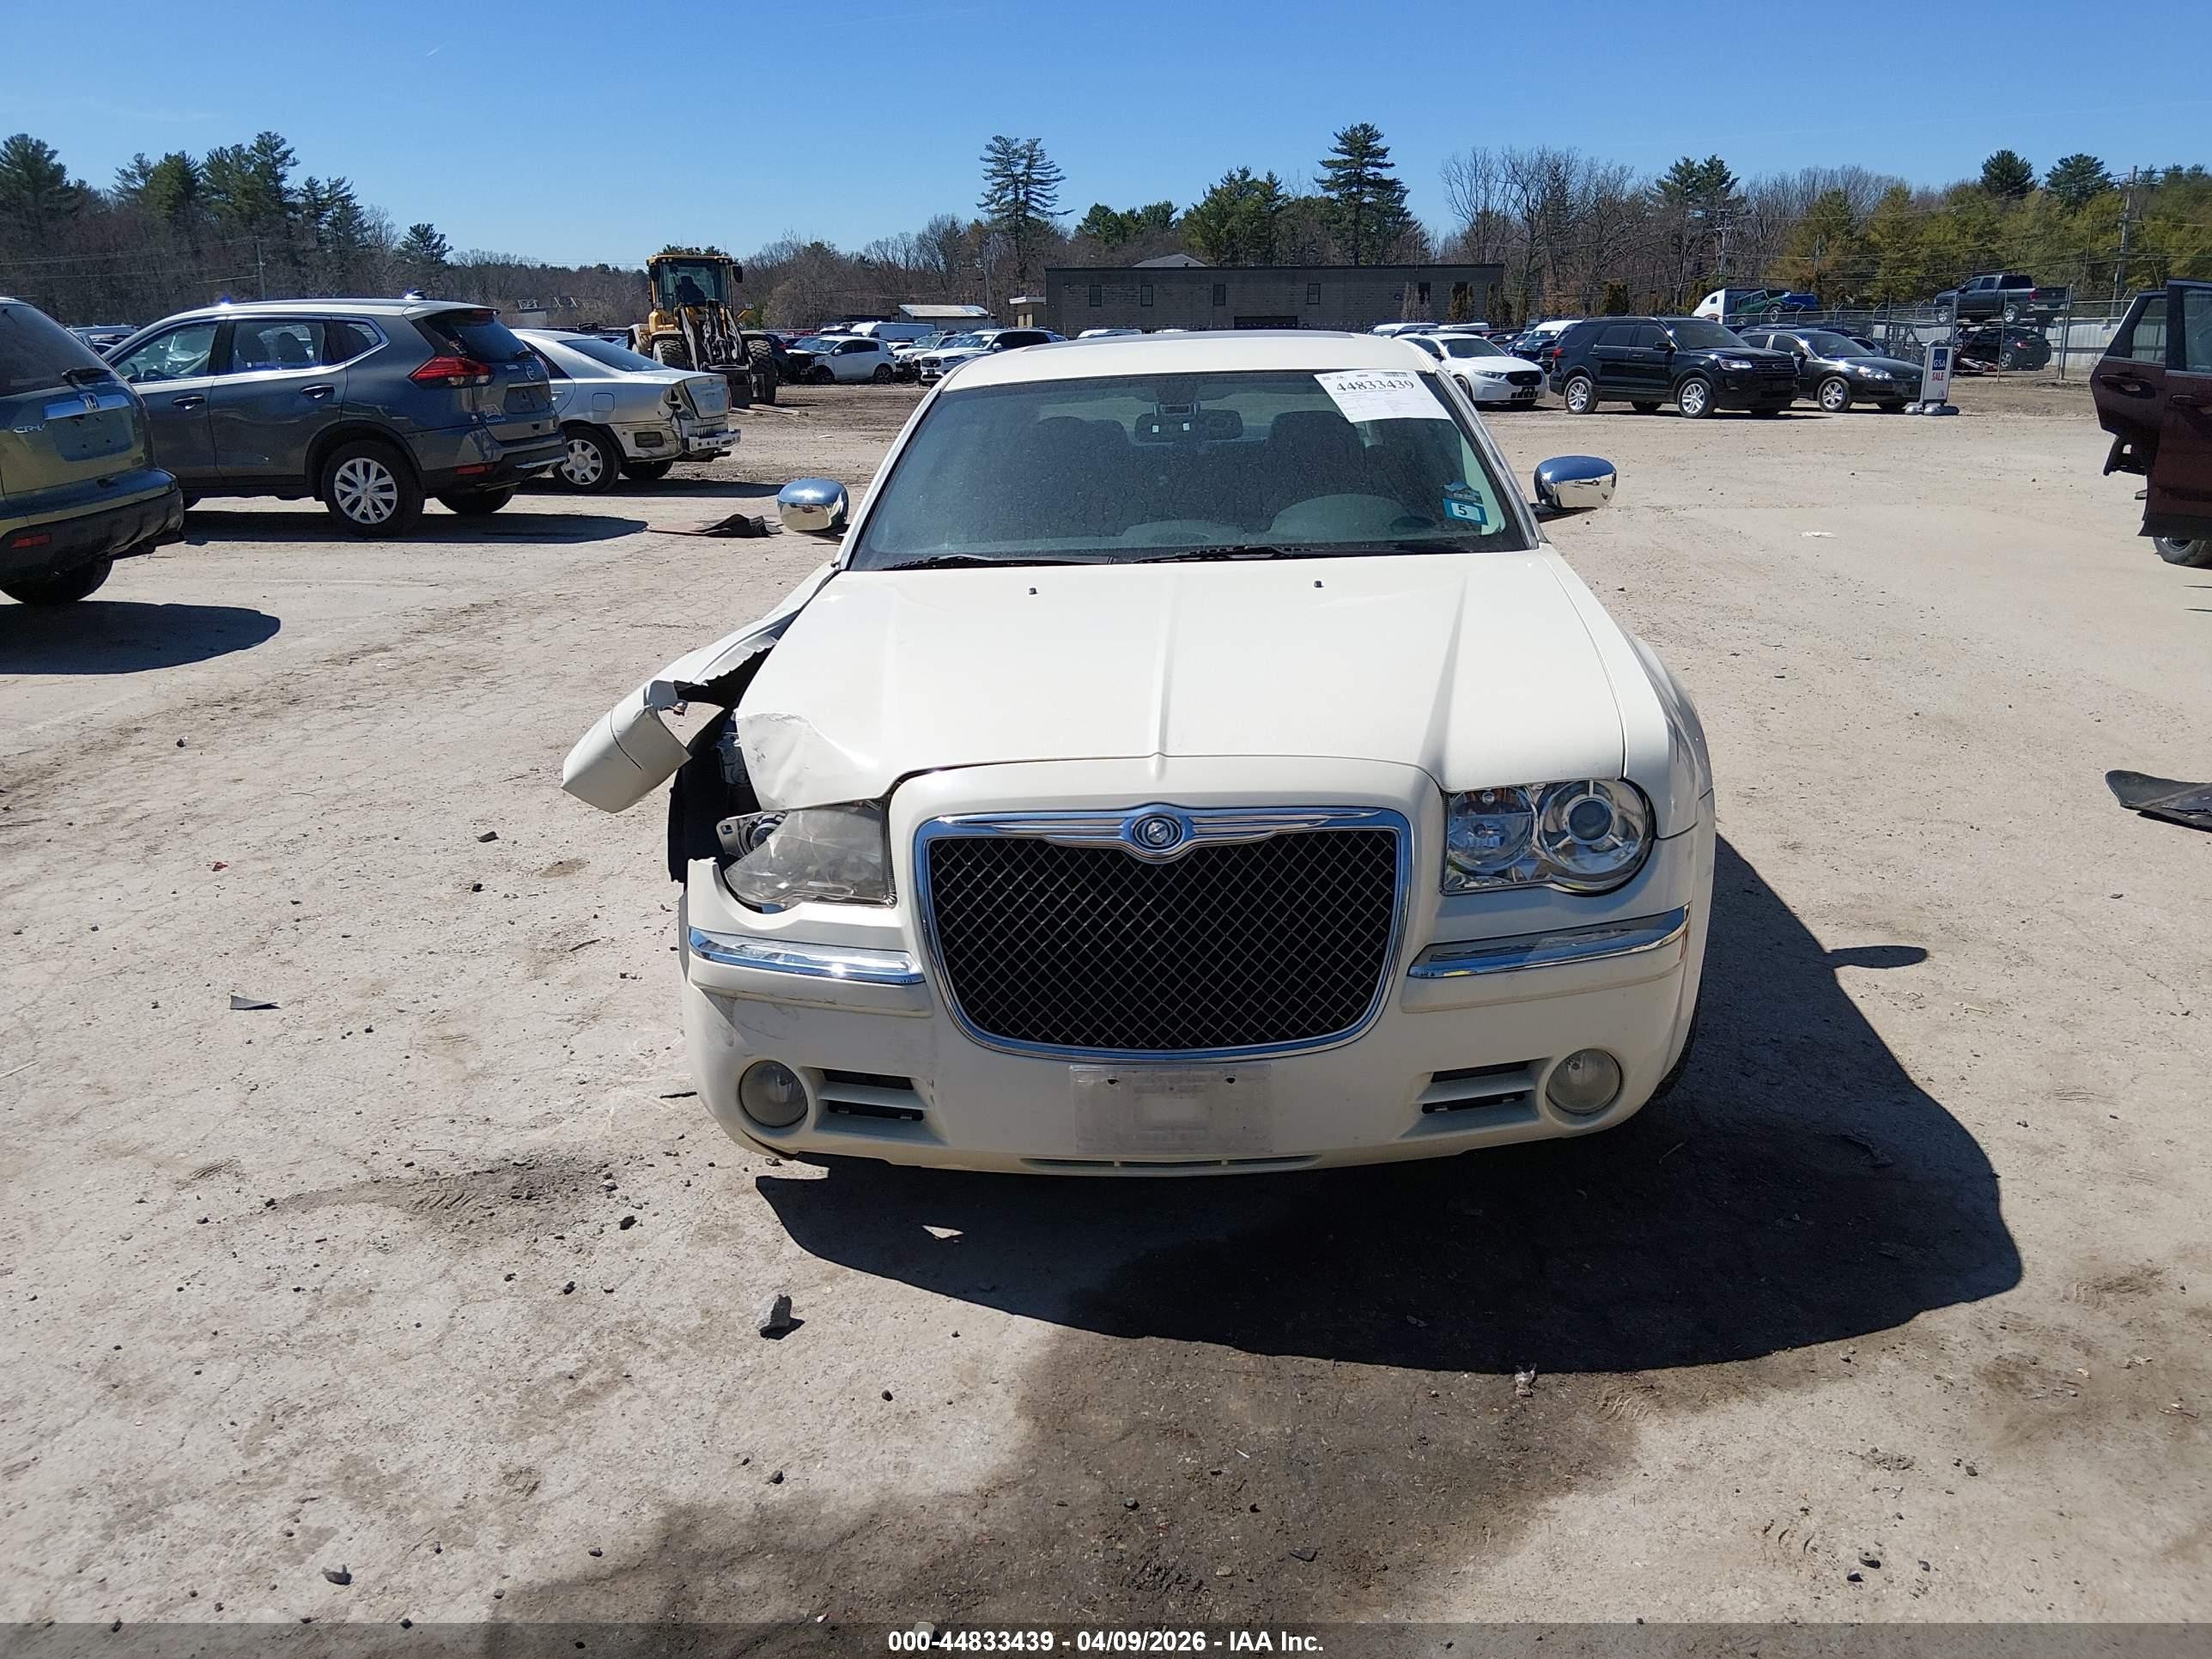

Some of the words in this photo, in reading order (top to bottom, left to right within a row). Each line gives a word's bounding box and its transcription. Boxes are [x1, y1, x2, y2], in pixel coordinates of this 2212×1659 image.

[1934, 359, 1945, 368] GSA
[1932, 372, 1944, 380] SALE
[1337, 380, 1414, 392] 44833439
[13, 423, 46, 433] CR-V
[1457, 505, 1468, 516] 5
